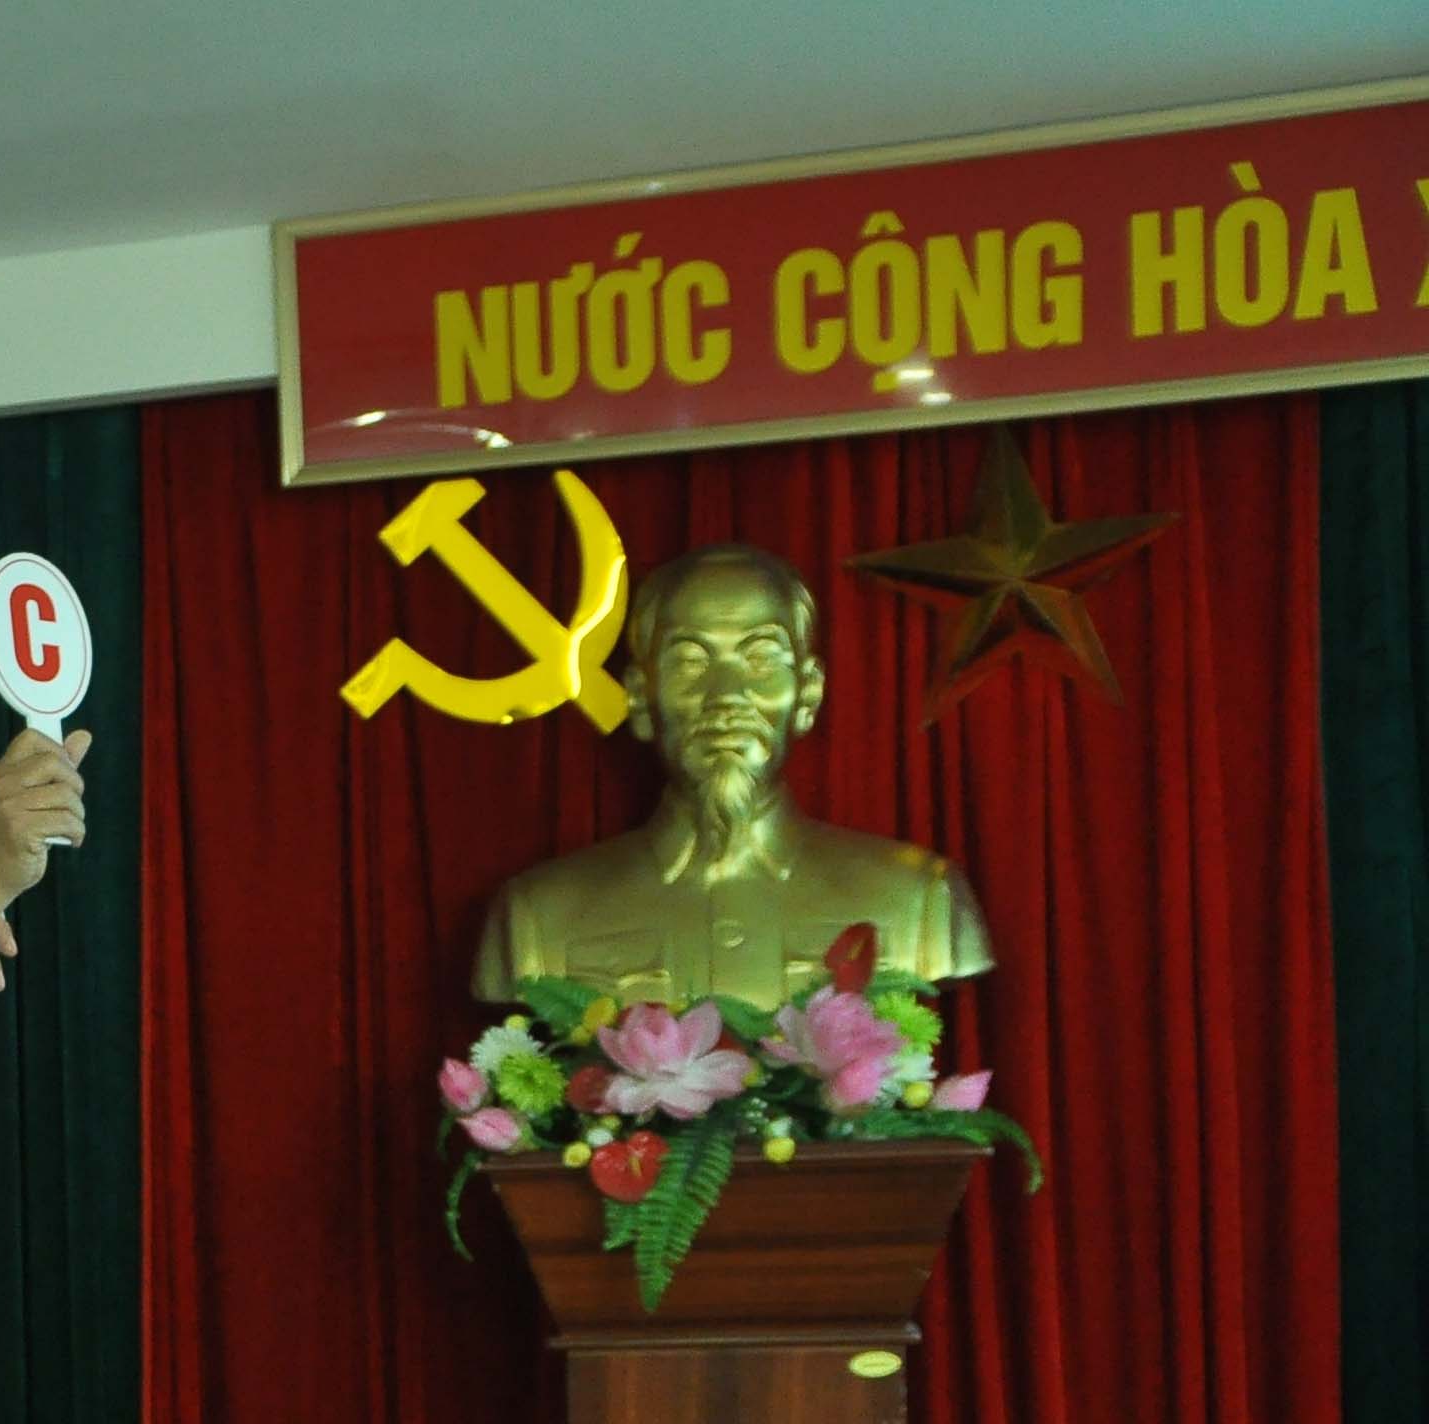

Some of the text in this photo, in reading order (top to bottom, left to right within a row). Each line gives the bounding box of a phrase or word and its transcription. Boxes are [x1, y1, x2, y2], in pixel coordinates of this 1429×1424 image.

[435, 232, 732, 409] NƯỚC
[774, 212, 1084, 393] CỘNG
[1129, 161, 1379, 339] HÒA
[9, 583, 62, 683] C
